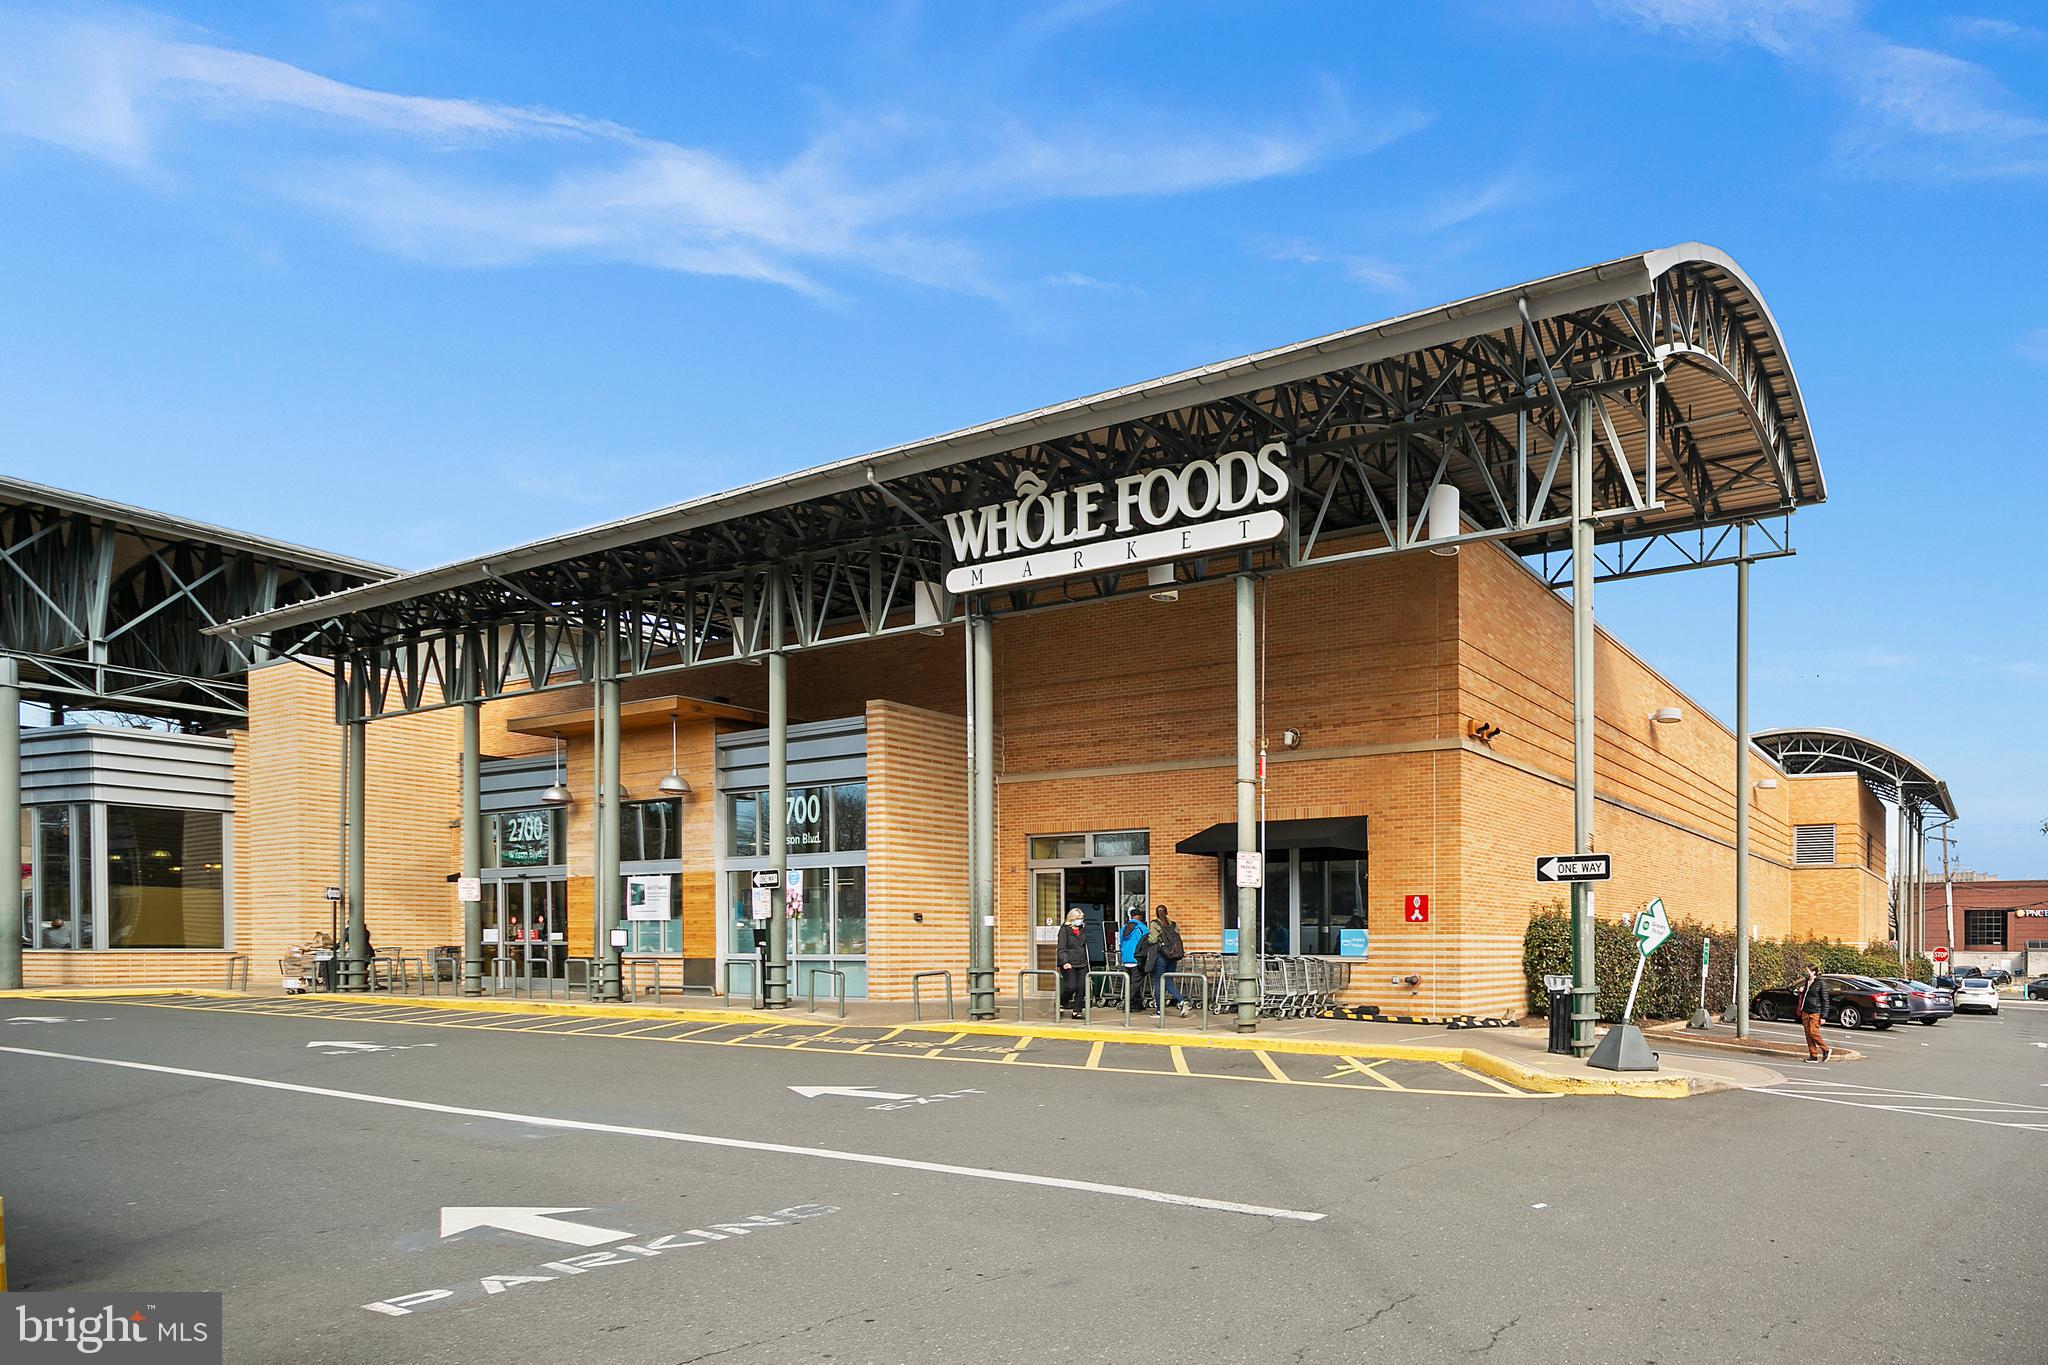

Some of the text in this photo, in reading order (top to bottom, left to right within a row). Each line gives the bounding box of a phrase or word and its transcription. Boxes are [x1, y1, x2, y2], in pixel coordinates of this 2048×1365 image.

[943, 441, 1290, 562] WHOLE FOODS
[971, 519, 1251, 586] MARKET
[507, 816, 544, 842] 2700
[785, 794, 820, 825] 700
[1558, 862, 1602, 874] ONE WAY
[360, 1203, 842, 1317] PARKING
